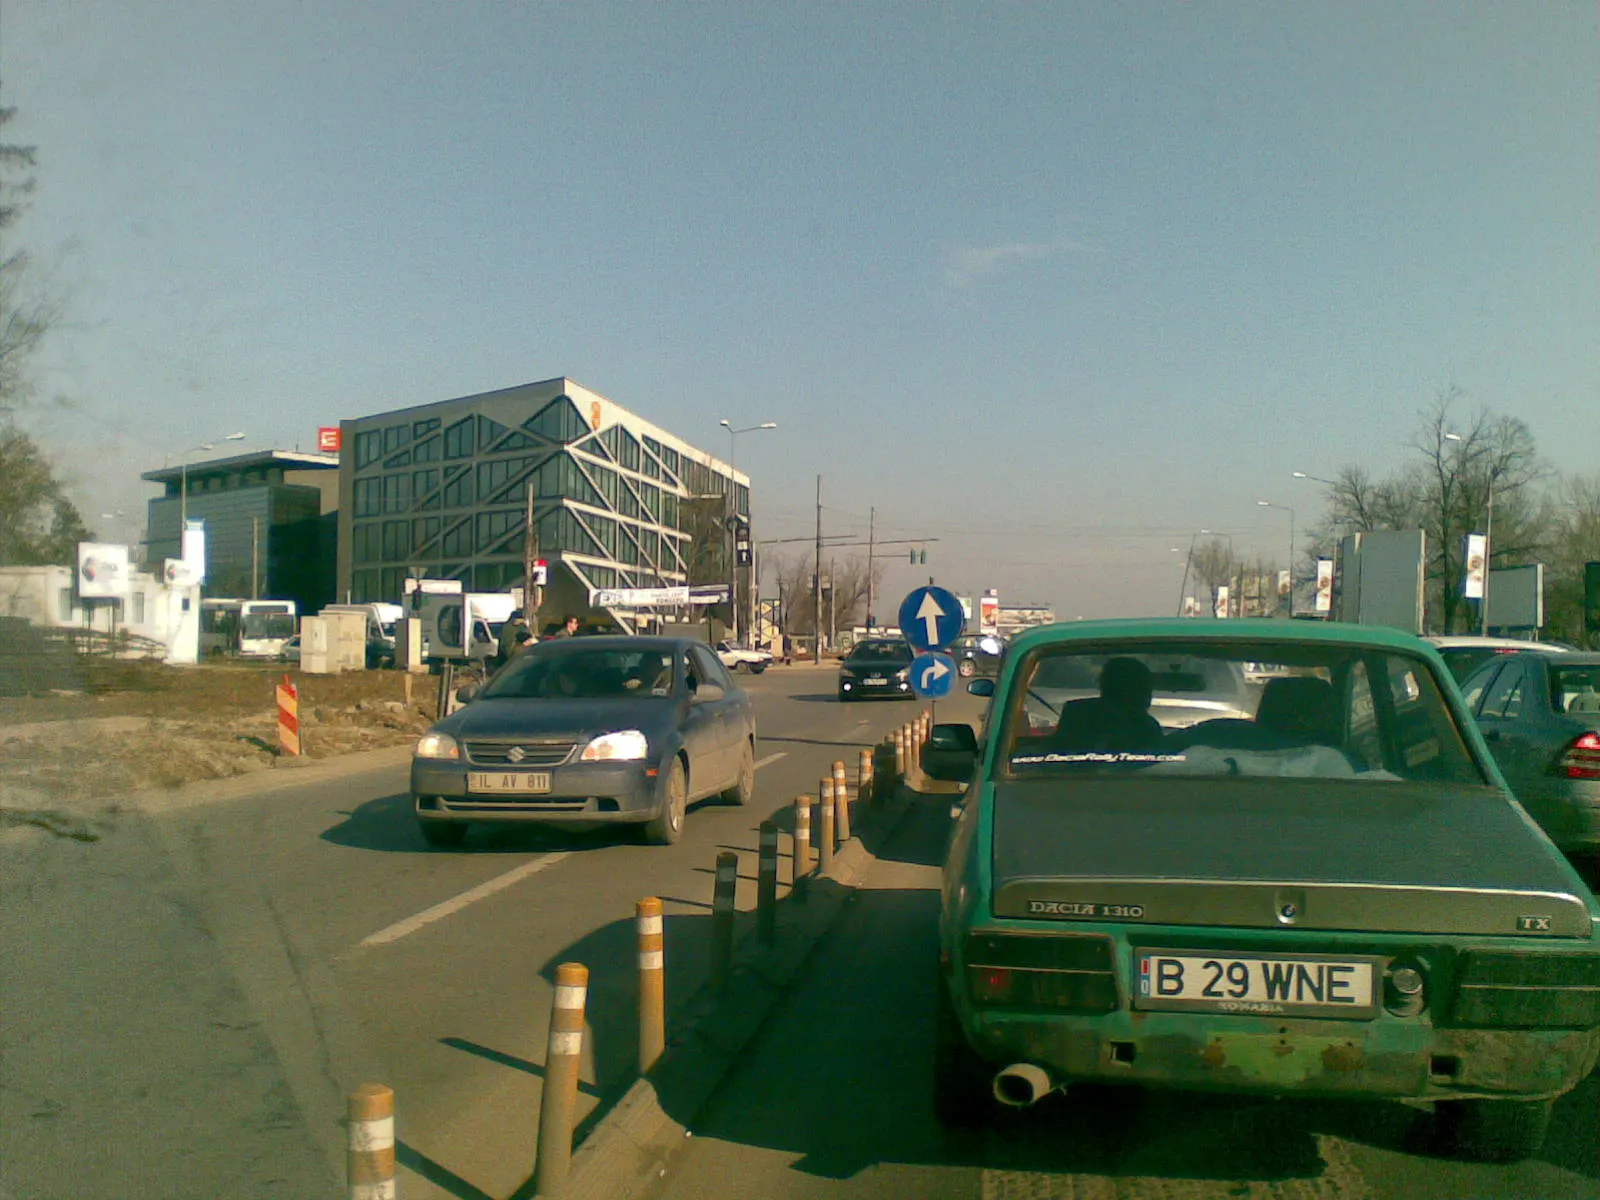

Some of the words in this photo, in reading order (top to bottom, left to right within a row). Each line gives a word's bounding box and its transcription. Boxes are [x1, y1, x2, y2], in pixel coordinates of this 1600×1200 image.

[502, 774, 517, 788] AV
[1029, 901, 1096, 915] DACIA
[1103, 906, 1143, 918] 1310
[1157, 959, 1185, 996] B
[1202, 960, 1249, 998] 29
[1261, 962, 1356, 1003] WNE
